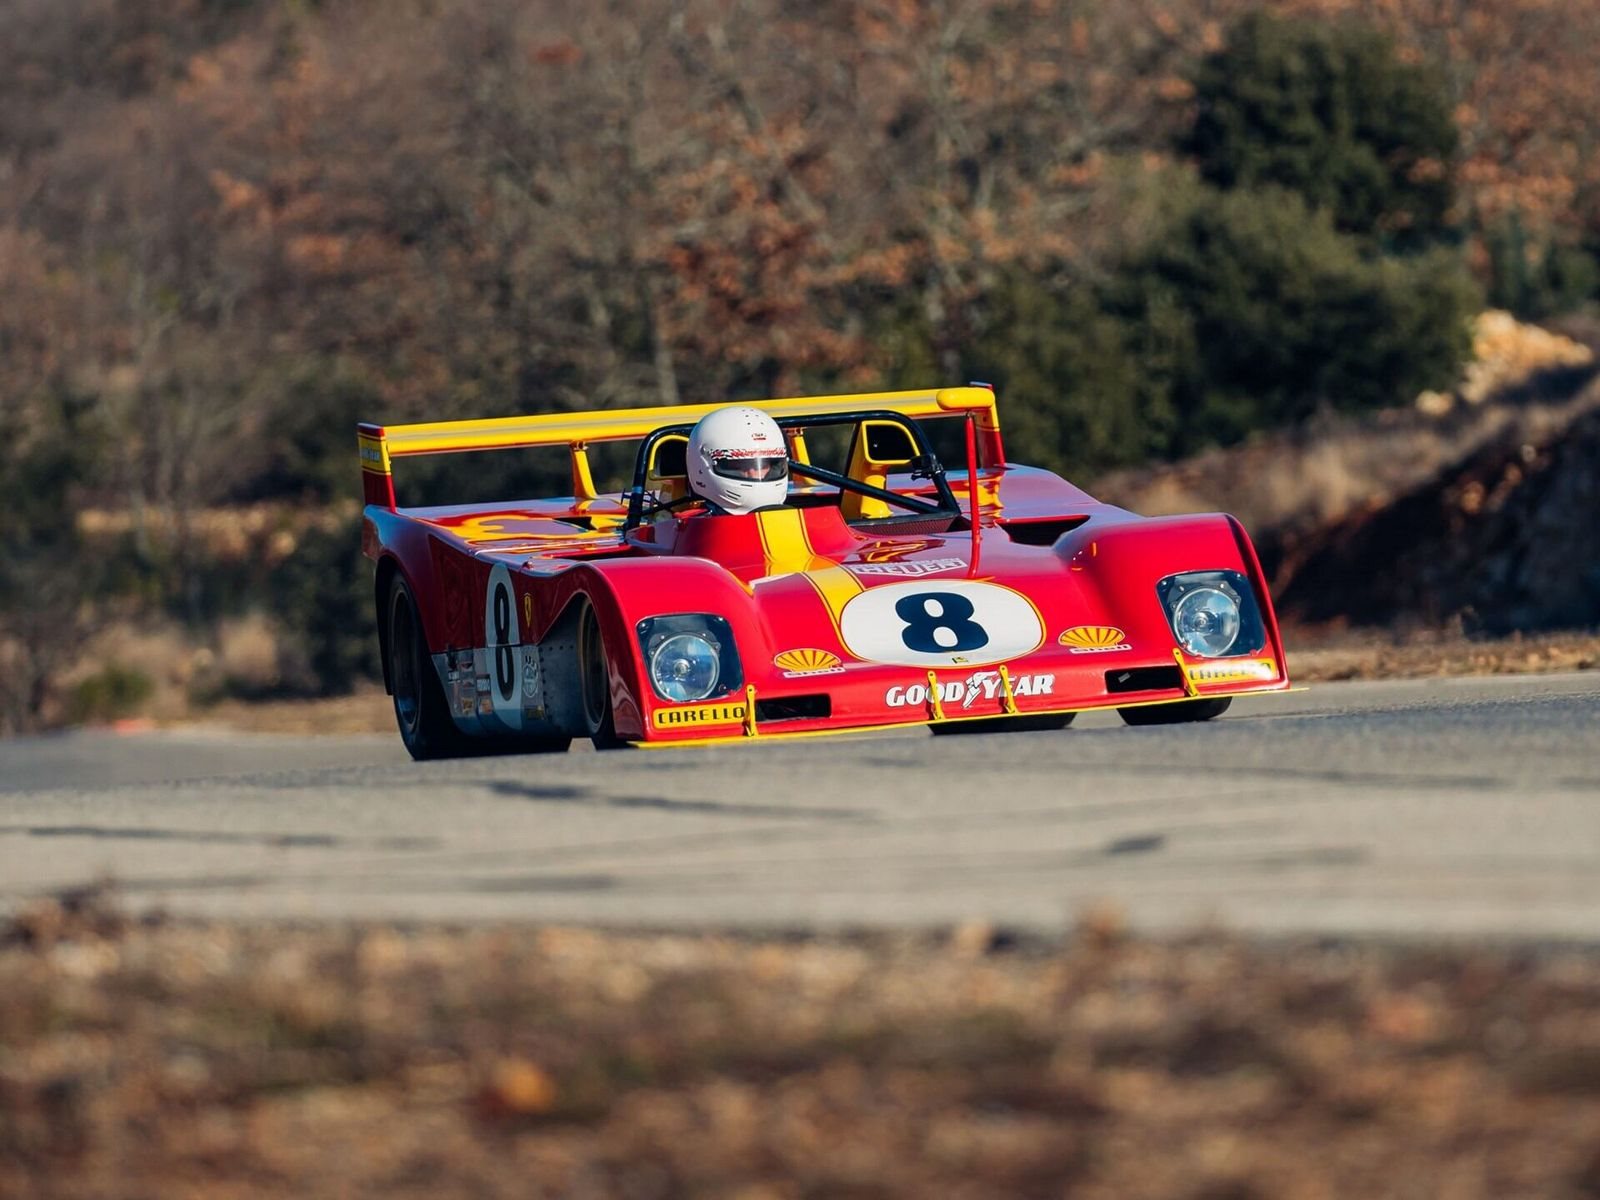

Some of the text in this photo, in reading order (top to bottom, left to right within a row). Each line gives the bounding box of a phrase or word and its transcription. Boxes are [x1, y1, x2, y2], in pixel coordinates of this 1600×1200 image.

[494, 582, 514, 701] 8
[895, 591, 990, 653] 8
[1190, 663, 1271, 681] CAREL
[658, 706, 745, 724] CARELLO
